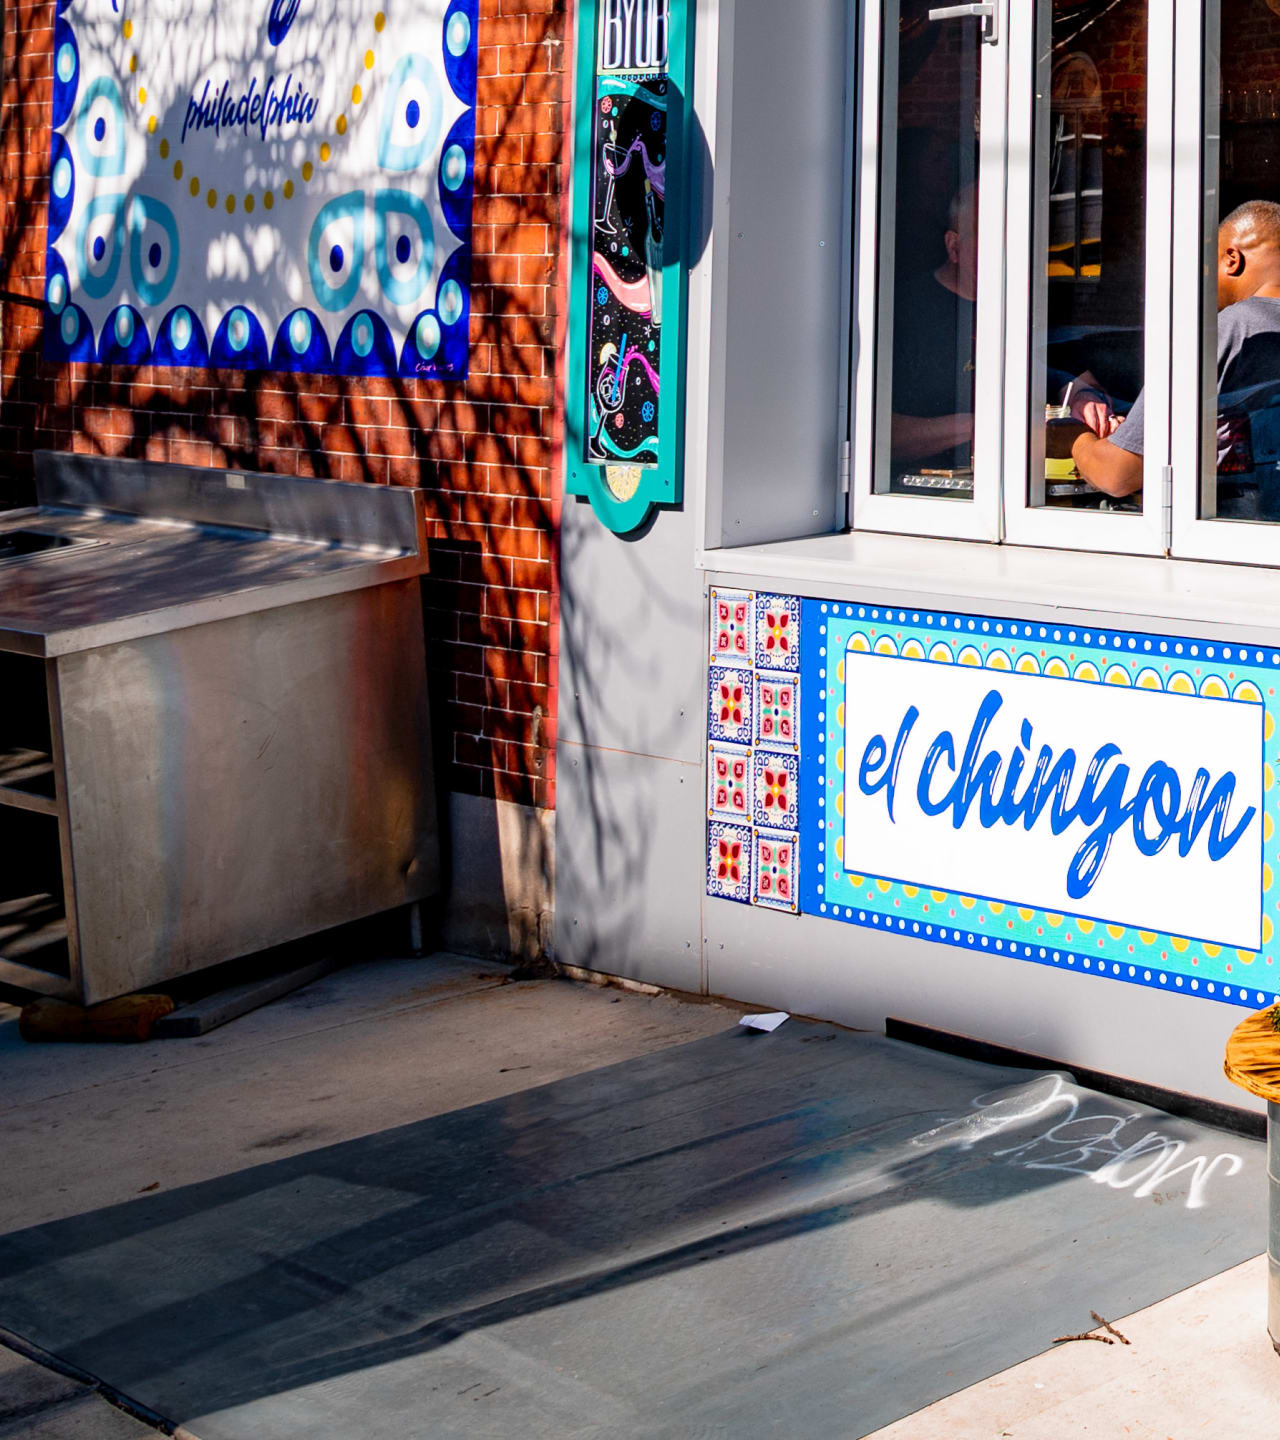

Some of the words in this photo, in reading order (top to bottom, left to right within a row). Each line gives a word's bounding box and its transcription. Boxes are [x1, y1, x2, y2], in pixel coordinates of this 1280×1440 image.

[181, 73, 319, 144] philadelphia
[857, 704, 920, 824] el
[916, 689, 1257, 900] chingon
